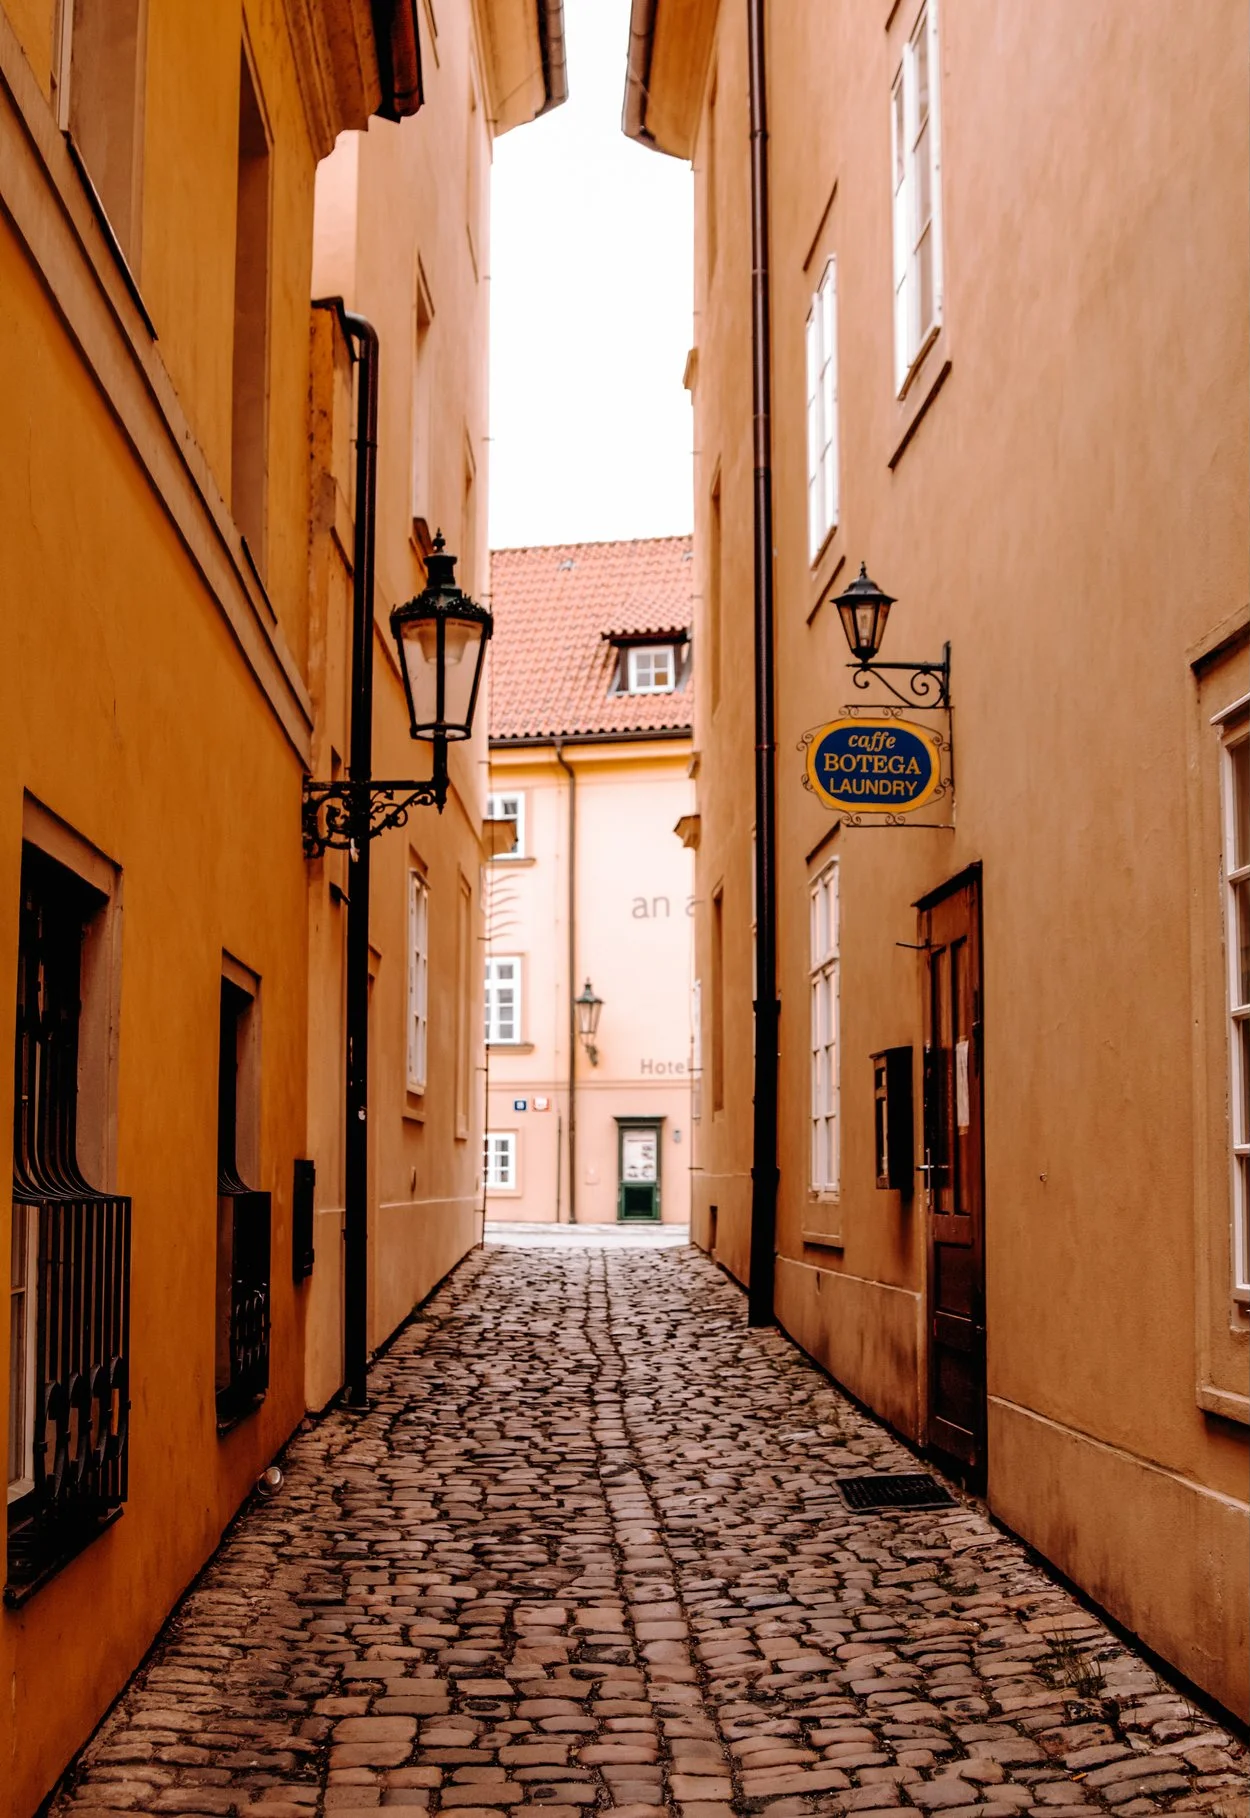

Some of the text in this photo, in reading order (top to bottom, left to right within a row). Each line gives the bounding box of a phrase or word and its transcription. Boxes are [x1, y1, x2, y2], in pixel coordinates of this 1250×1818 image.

[848, 732, 896, 752] caffe
[823, 753, 922, 775] BOTEGA
[829, 777, 918, 796] LAUNDRY
[632, 896, 670, 919] an
